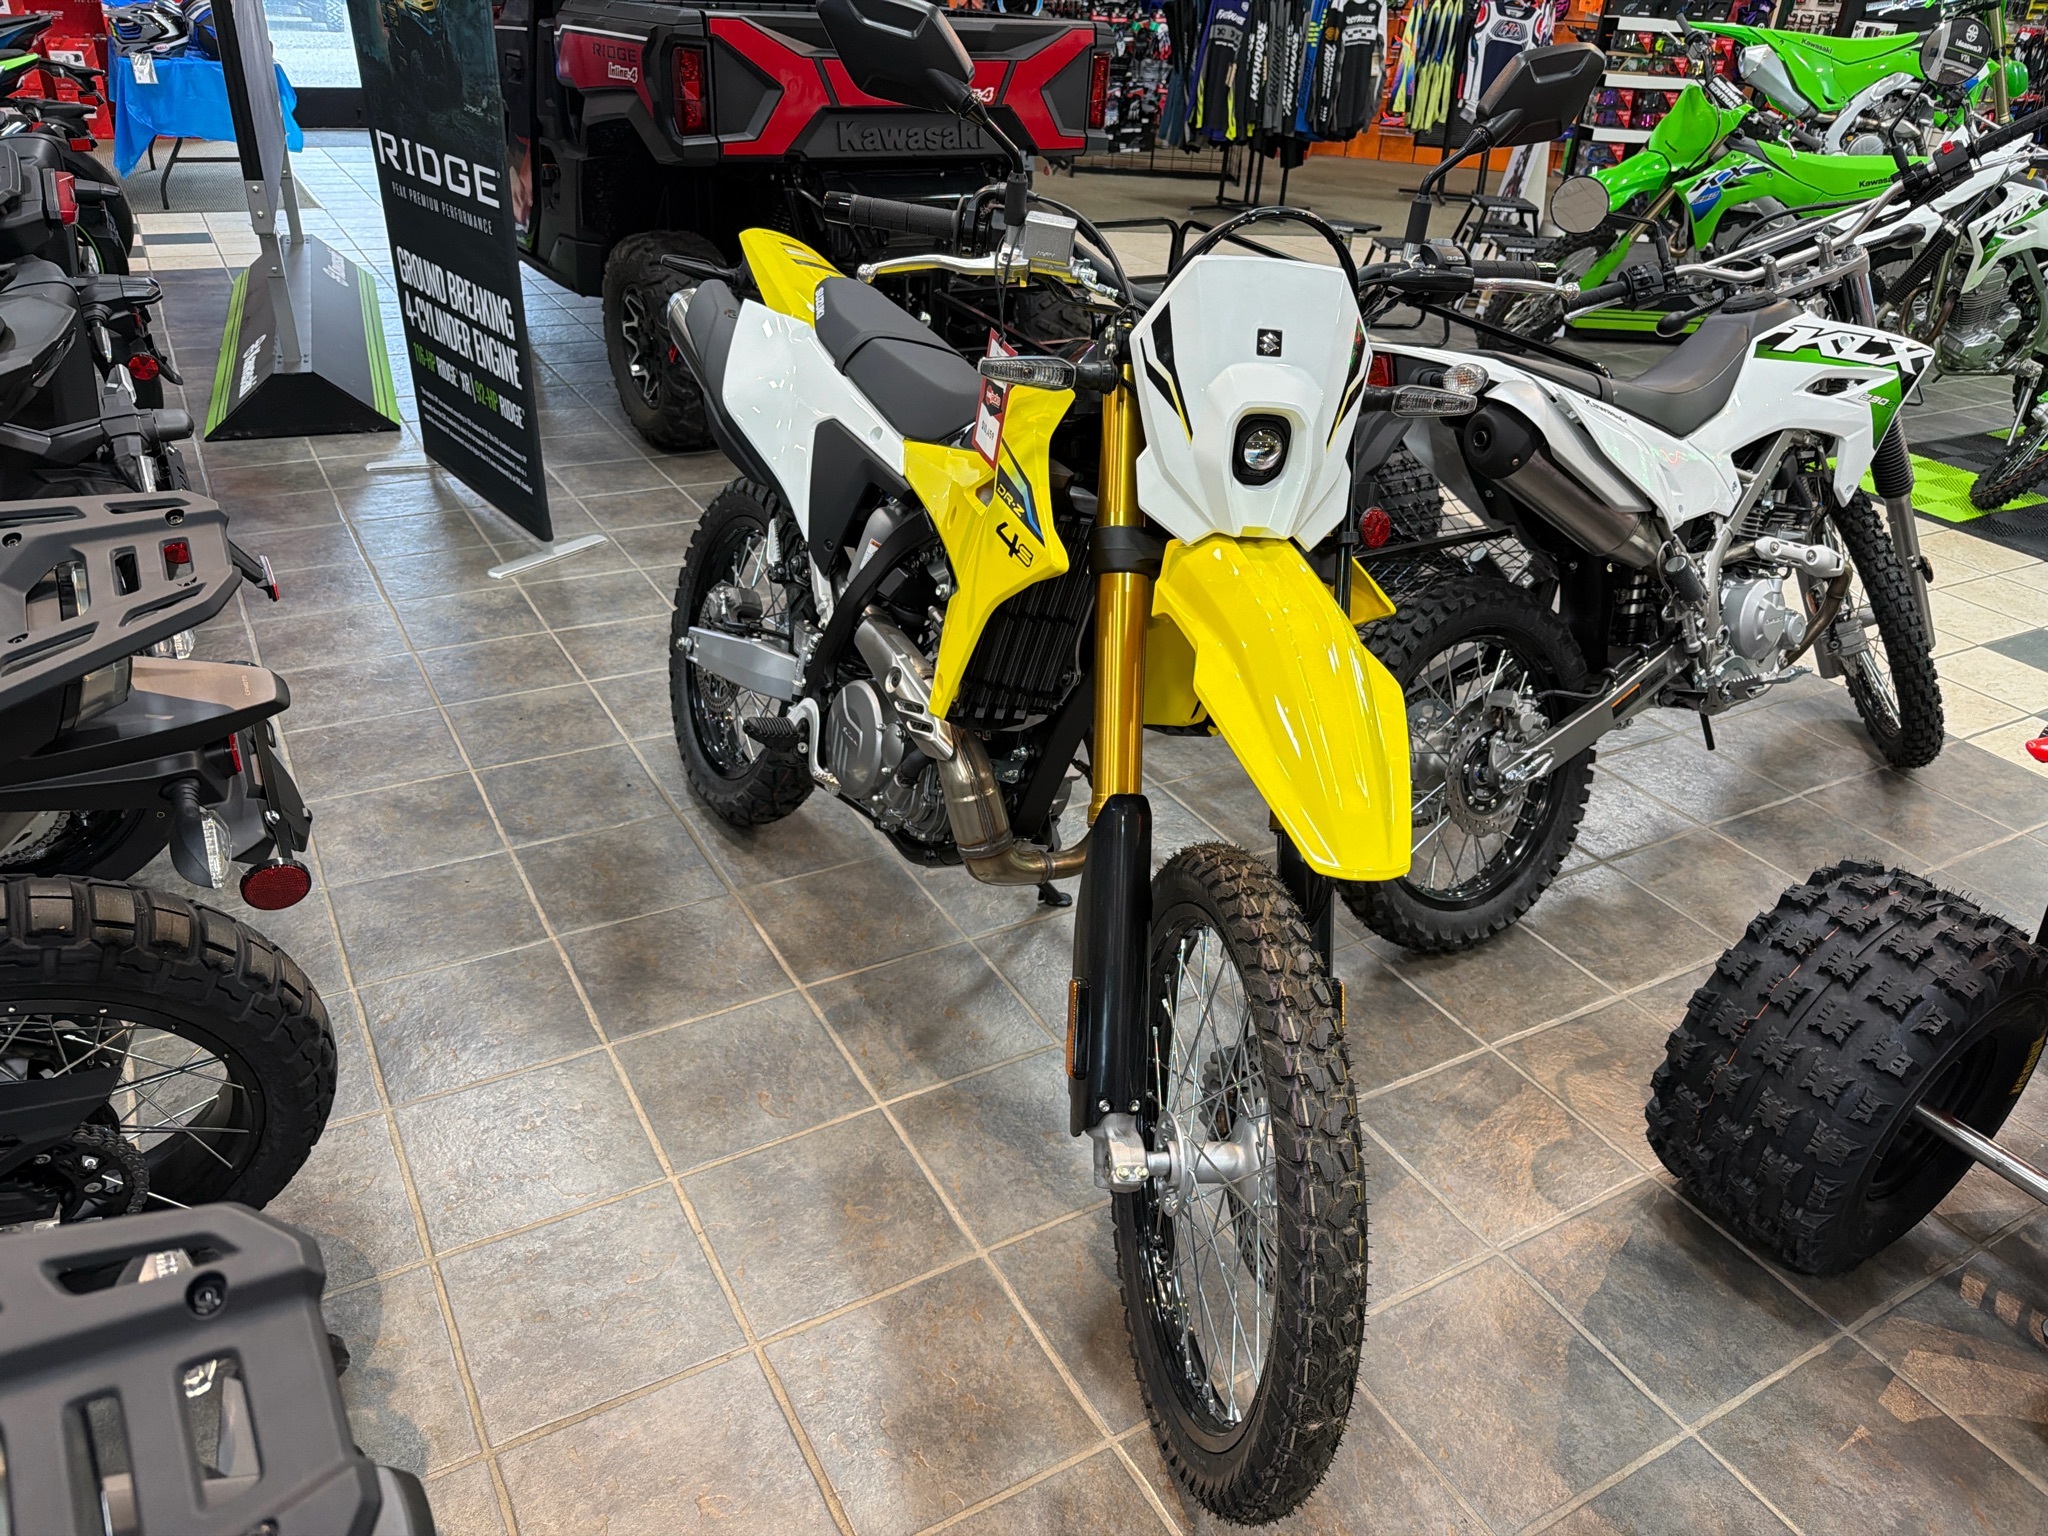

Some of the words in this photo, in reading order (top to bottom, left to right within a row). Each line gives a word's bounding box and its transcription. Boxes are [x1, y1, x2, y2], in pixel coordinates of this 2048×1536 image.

[592, 43, 637, 62] RIDGE
[1801, 38, 1833, 54] Kawasaki
[608, 62, 638, 83] Inline-4
[838, 121, 984, 152] Kawasaki
[375, 129, 500, 209] RIDGE
[1688, 160, 1752, 193] KX
[1858, 178, 1894, 188] Kawasa
[391, 181, 408, 199] PEAK
[408, 188, 439, 213] PREMIUM
[441, 201, 493, 236] PERFORMANCE
[397, 245, 447, 305] GROUND
[446, 270, 516, 341] BREAKING
[815, 287, 825, 321] SUZUKI
[405, 290, 474, 362] 4-CYLINDER
[472, 327, 523, 391] ENGINE
[1773, 325, 1936, 376] KLX
[475, 380, 498, 412] 92-HP
[498, 394, 525, 430] RIDGE
[996, 484, 1025, 518] DR-Z
